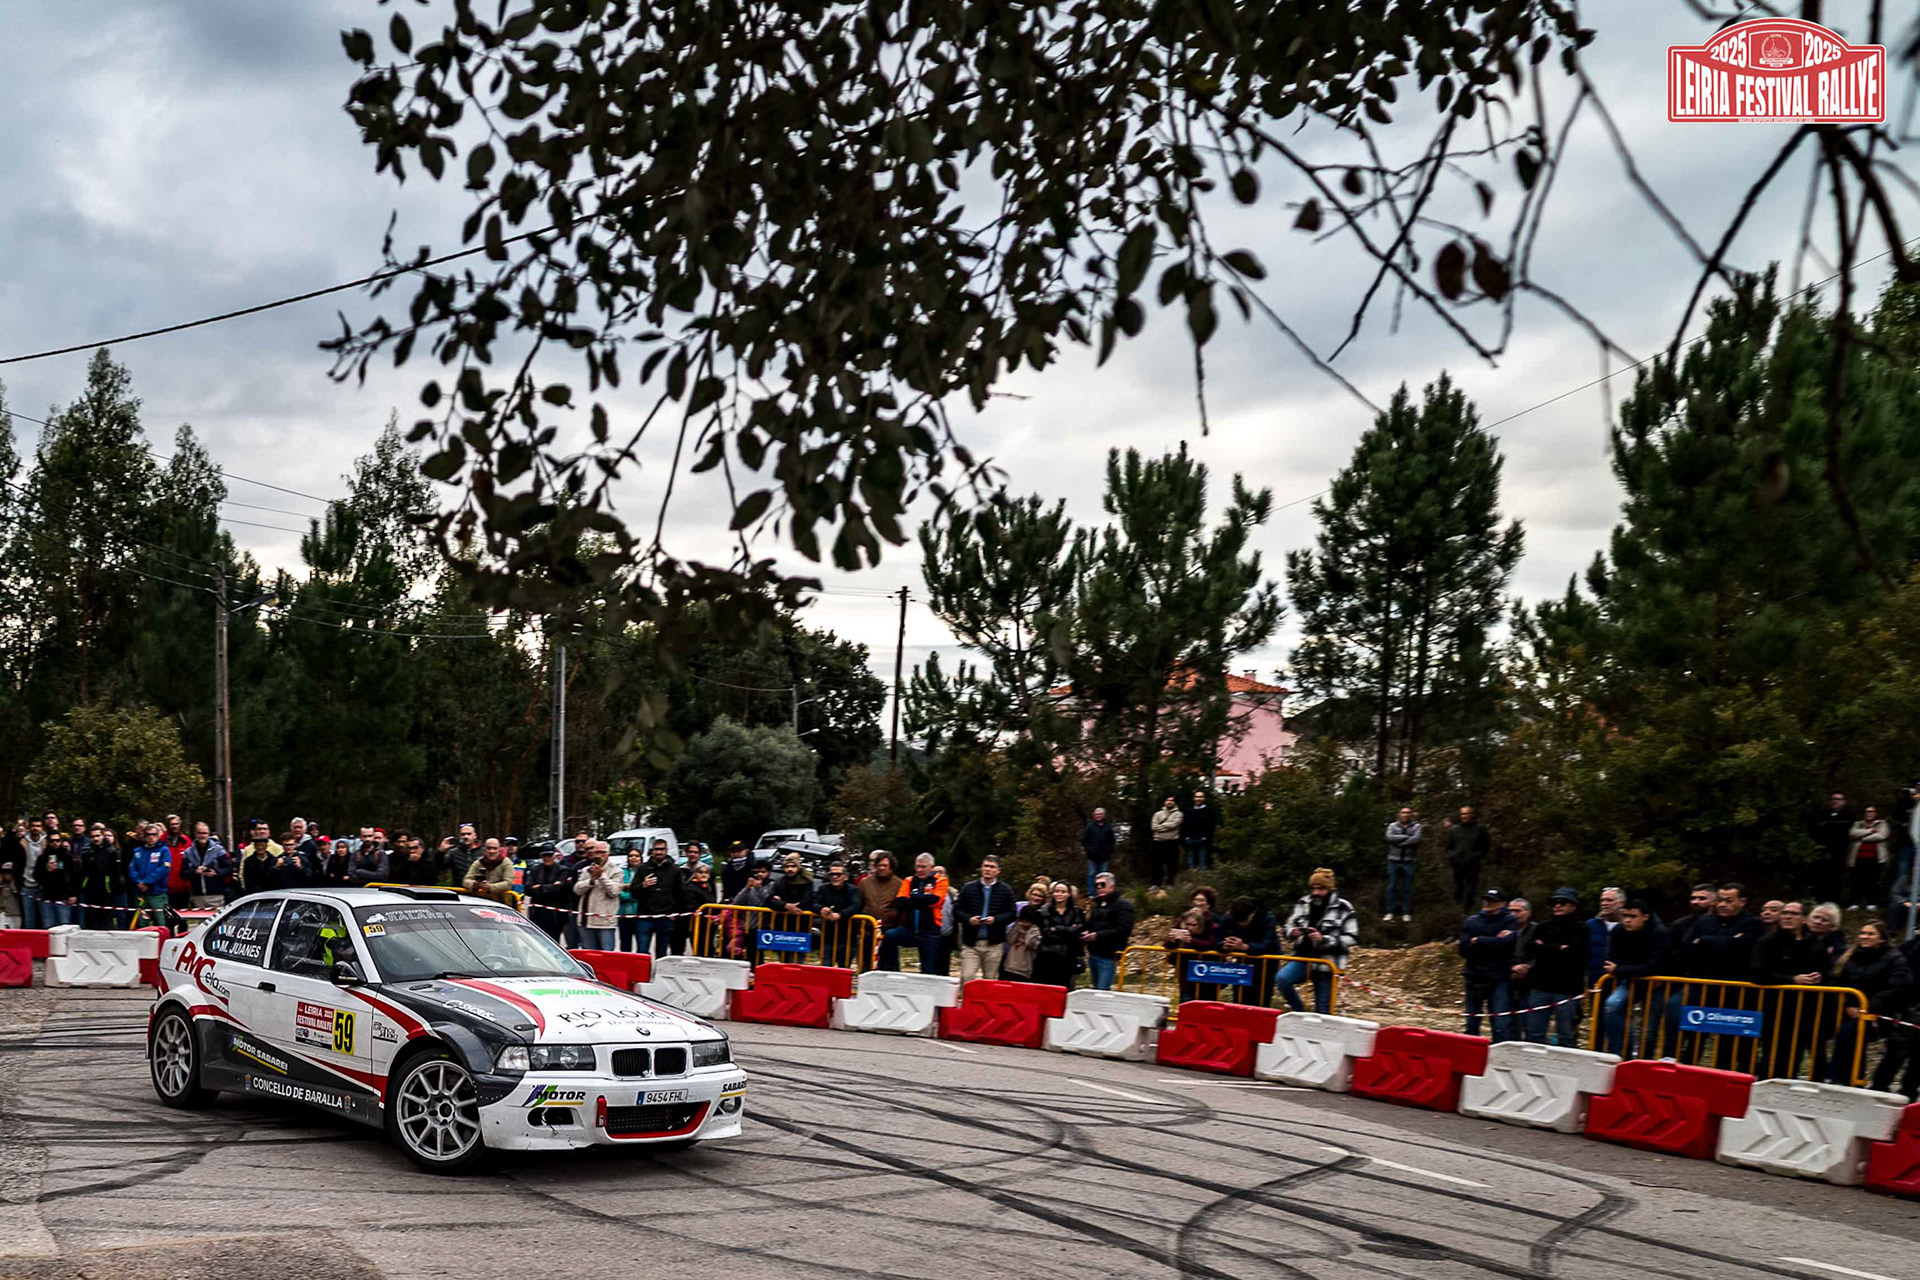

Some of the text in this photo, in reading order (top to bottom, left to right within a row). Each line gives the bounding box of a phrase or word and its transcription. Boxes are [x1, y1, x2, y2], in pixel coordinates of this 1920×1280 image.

[225, 925, 258, 941] M. CELA
[369, 925, 383, 933] 59
[219, 940, 261, 958] M. JUANES
[304, 1005, 323, 1017] LEIRIA
[1706, 1012, 1755, 1024] Oliveiras
[334, 1012, 354, 1053] 59
[233, 1038, 288, 1071] MOTOR SABAREI
[253, 1077, 343, 1108] CONCELLO DE BARALLA
[536, 1091, 586, 1101] MOTOR
